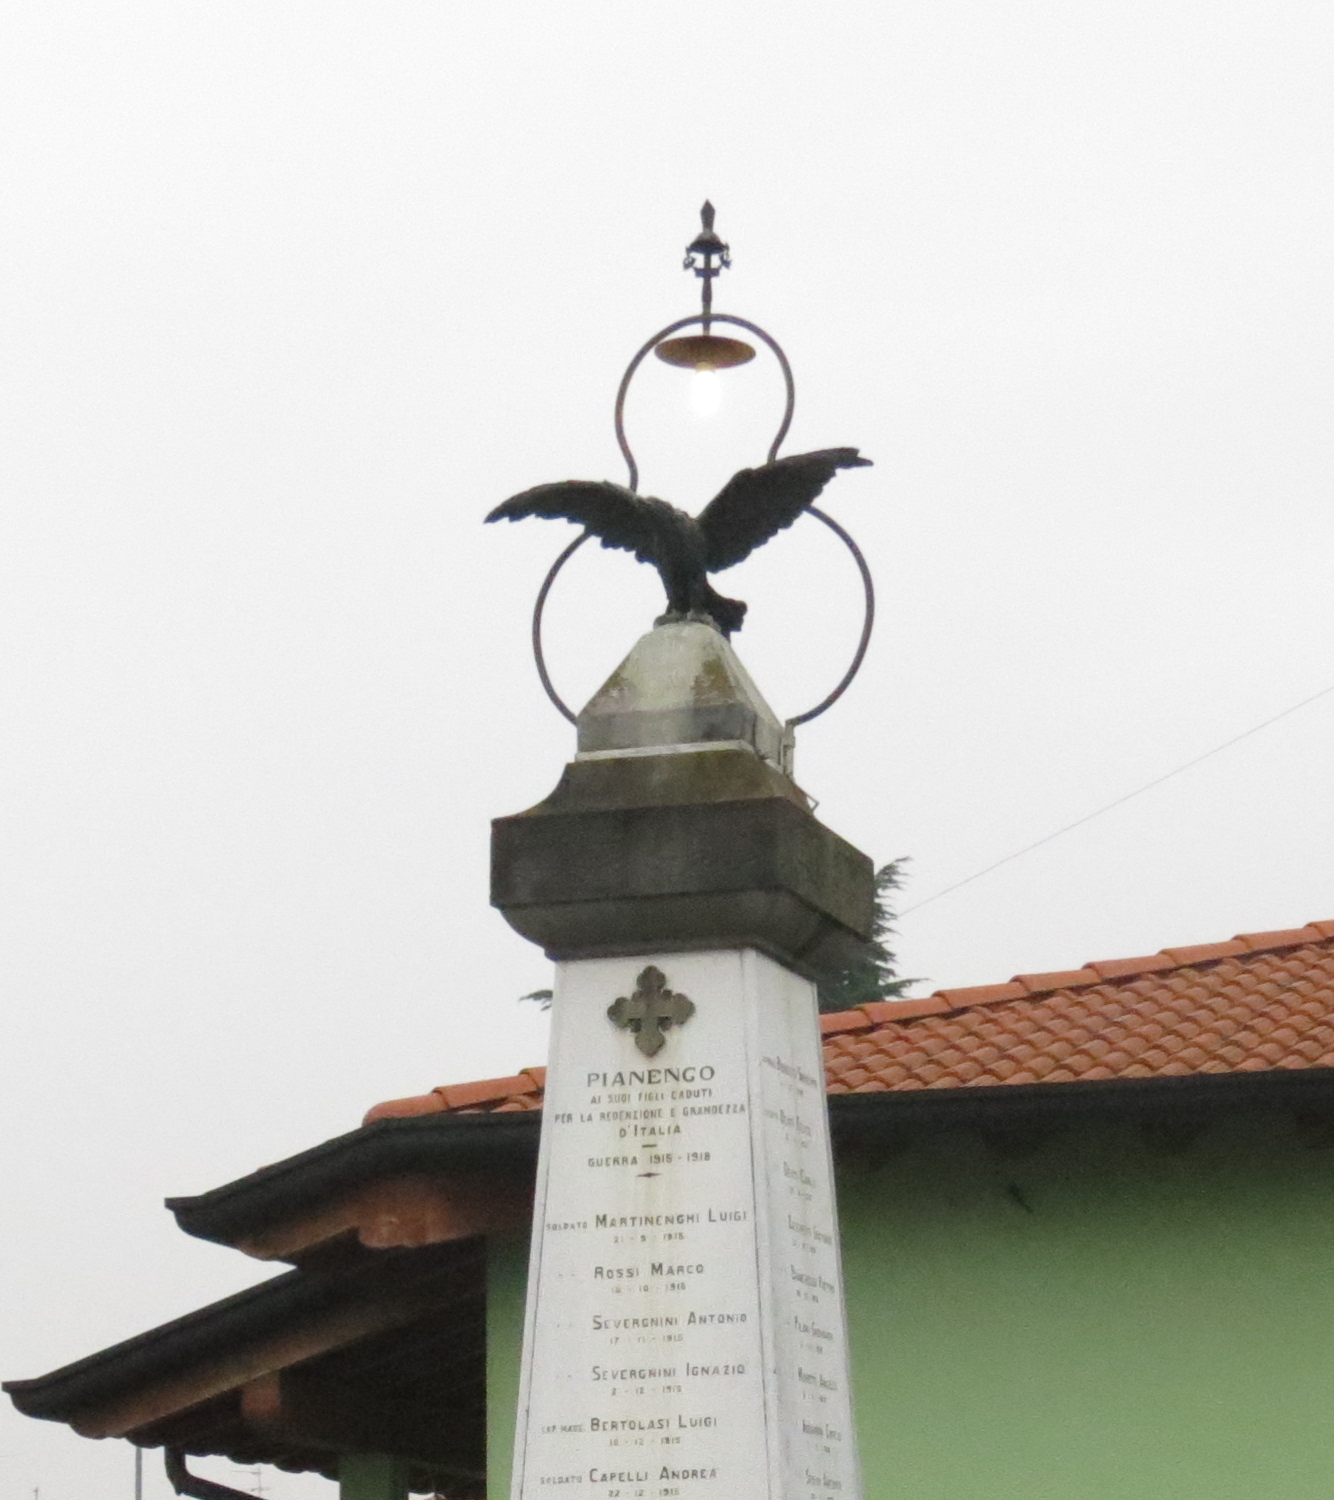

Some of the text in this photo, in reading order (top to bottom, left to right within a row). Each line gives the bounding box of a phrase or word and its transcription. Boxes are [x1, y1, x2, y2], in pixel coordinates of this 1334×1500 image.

[587, 1066, 716, 1088] PIANENGO
[590, 1095, 601, 1104] AI
[638, 1092, 664, 1102] FIGLI
[671, 1088, 712, 1100] CADUTI
[554, 1104, 746, 1124] PER LA REDENZIONE E GRANDEZZA
[619, 1124, 681, 1138] D'ITALIA
[588, 1156, 638, 1168] GUERRA
[546, 1208, 746, 1232] SOLDATO MARTINENGHI LUIGI
[594, 1262, 704, 1280] ROSSI MARCO
[592, 1312, 747, 1330] SEVERGNINI ANTONIO
[592, 1362, 746, 1380] SEVERGNINI IGNAZIO
[590, 1417, 669, 1432] BERTOLASI
[678, 1414, 716, 1428] LUIGI
[540, 1466, 717, 1485] SOLDATO CAPELLI ANDREA
